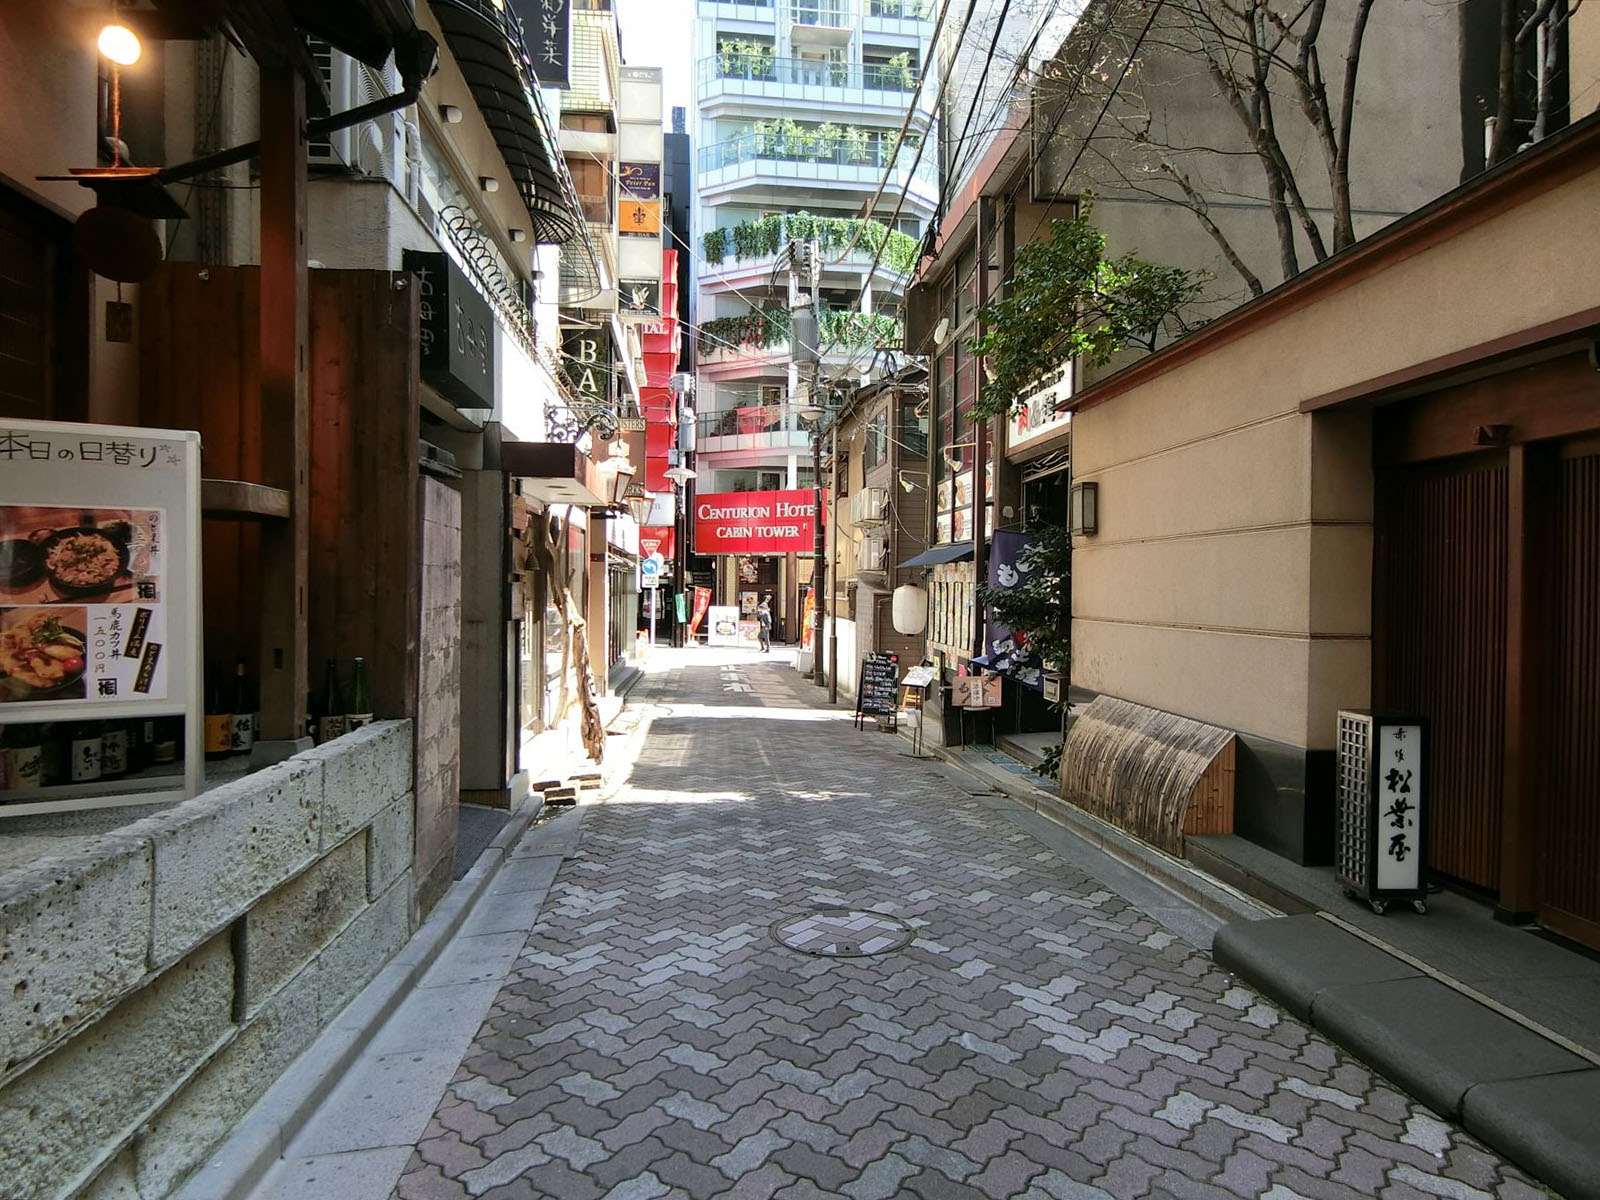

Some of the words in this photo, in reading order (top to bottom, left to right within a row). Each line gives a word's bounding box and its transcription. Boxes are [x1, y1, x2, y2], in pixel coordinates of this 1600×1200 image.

[697, 504, 770, 520] CENTURION
[775, 501, 816, 518] HOTE
[716, 526, 753, 538] CABIN
[755, 525, 800, 538] TOWER
